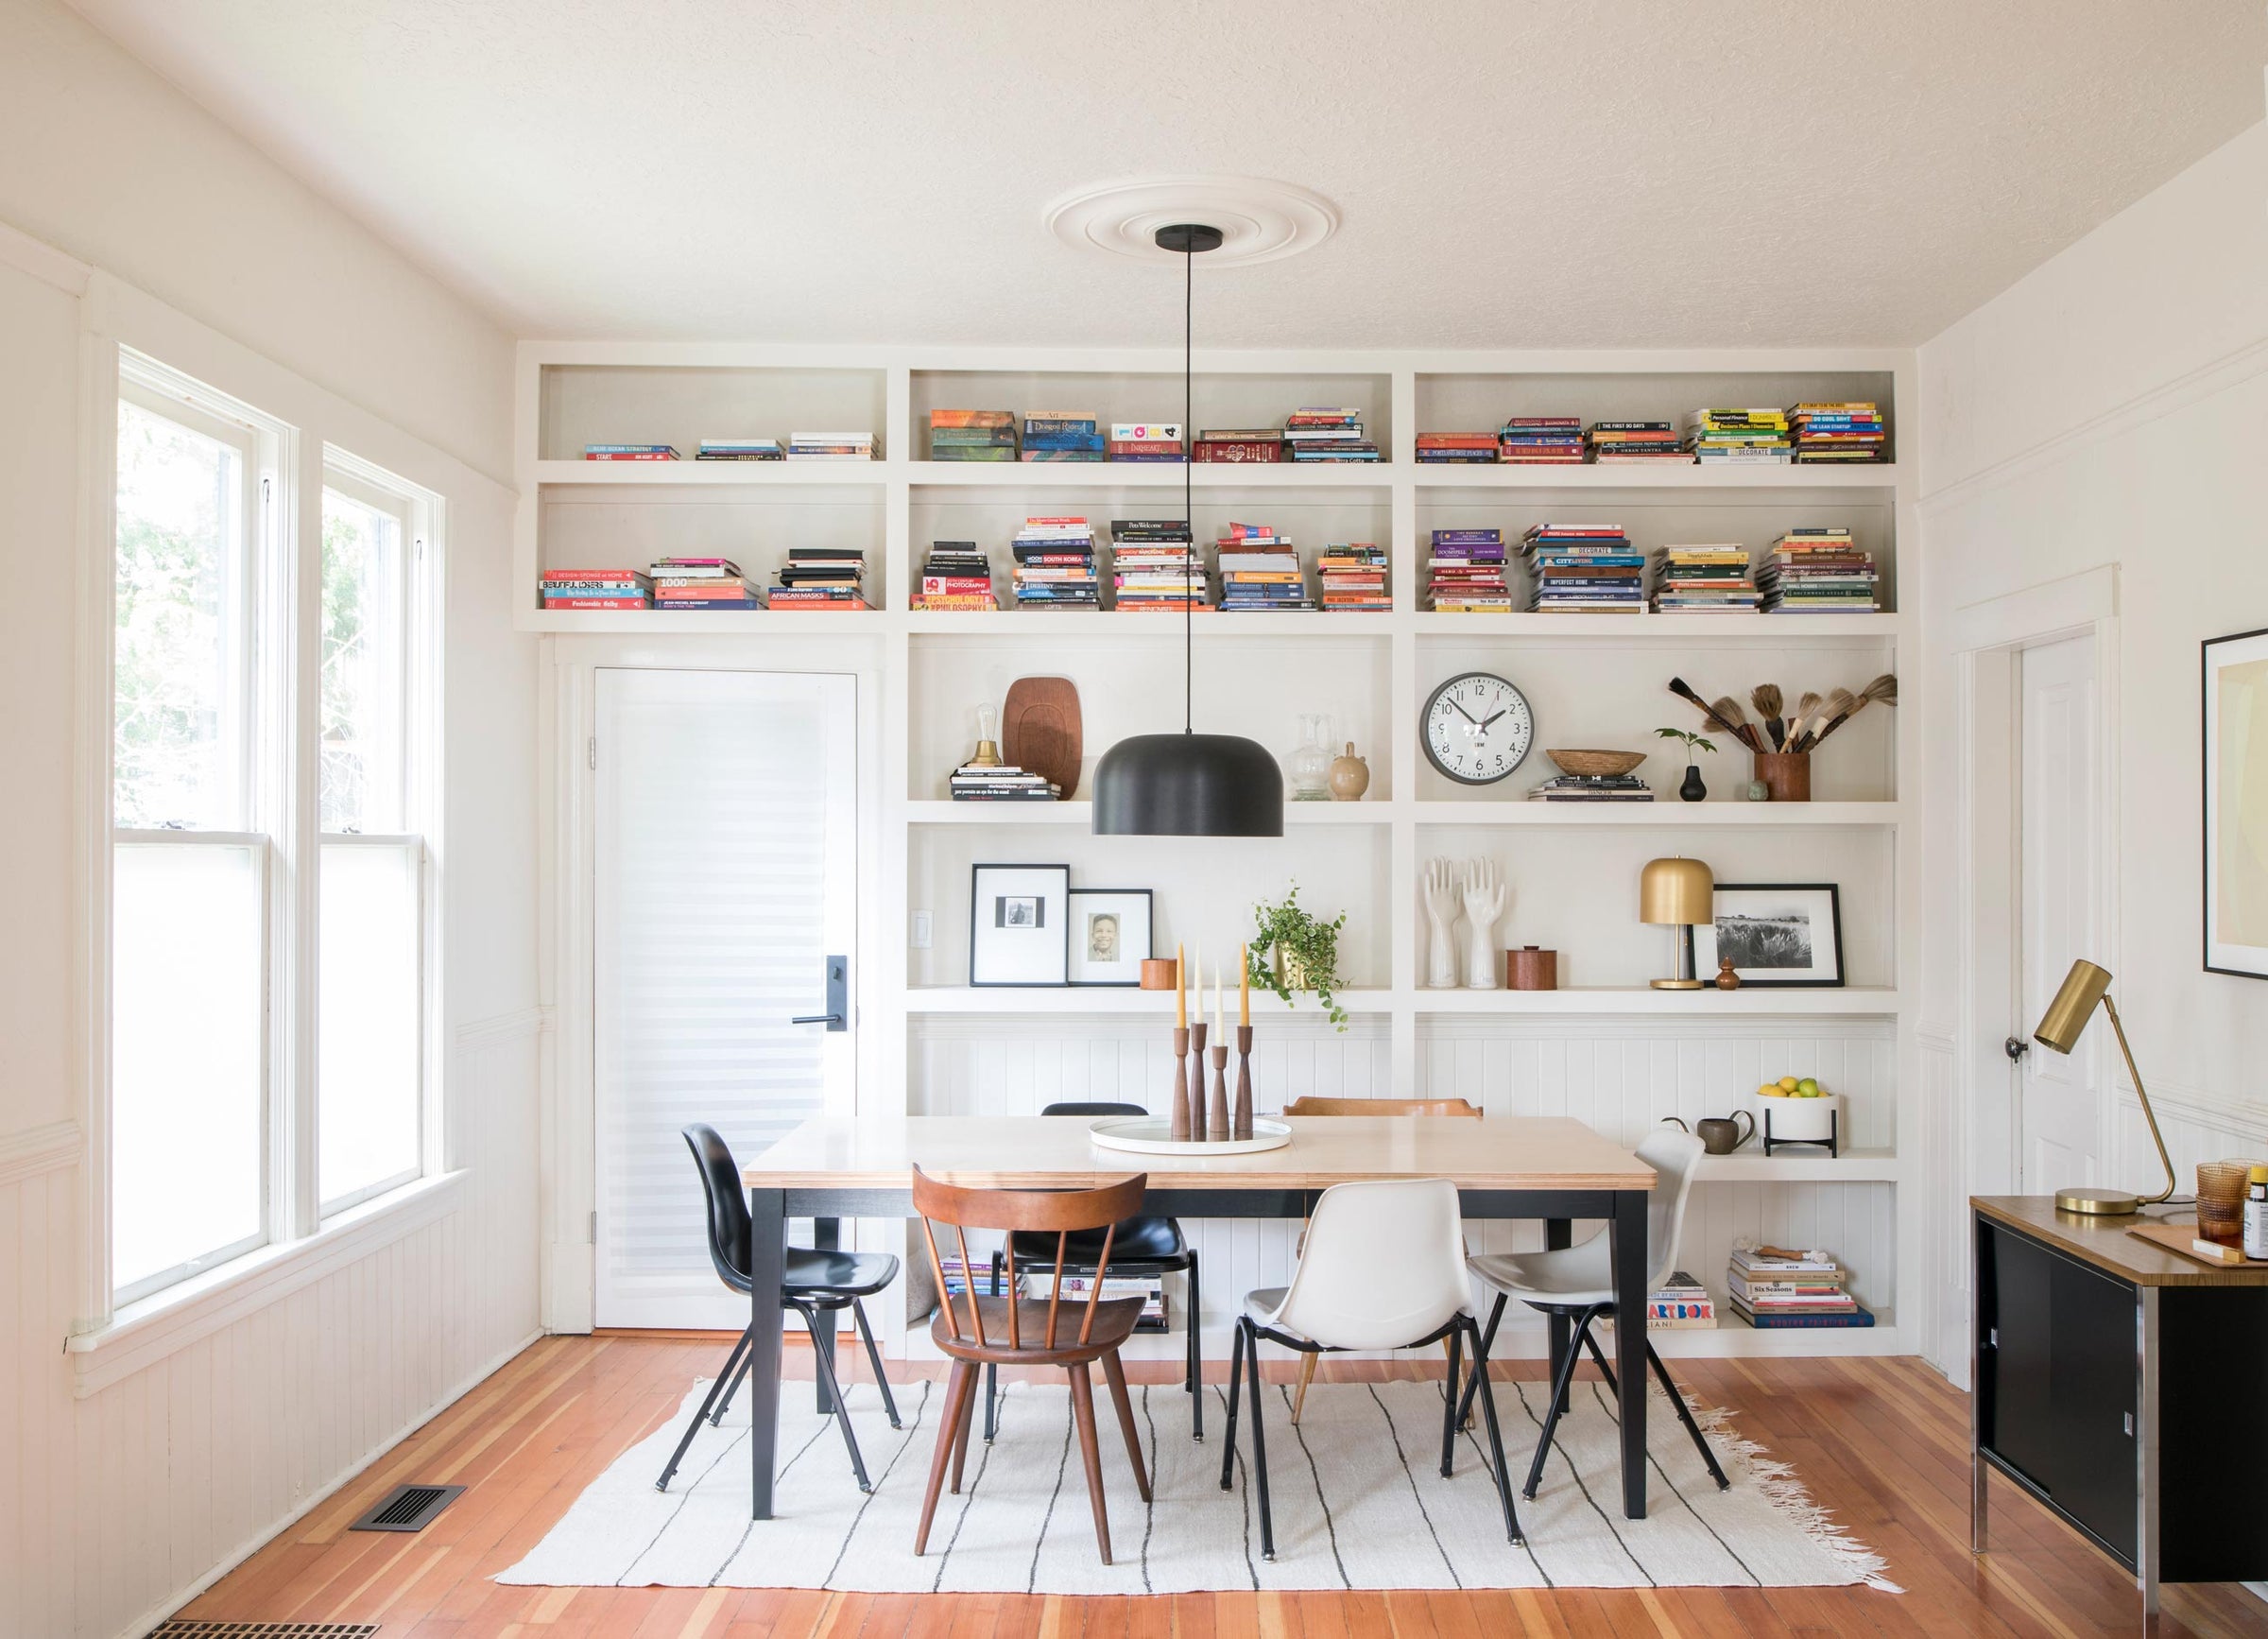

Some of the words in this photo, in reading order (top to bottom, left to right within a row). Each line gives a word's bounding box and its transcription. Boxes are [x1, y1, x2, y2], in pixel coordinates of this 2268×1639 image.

[1035, 422, 1061, 431] Dragon
[1062, 422, 1081, 431] Rider
[661, 578, 687, 587] 1000
[1475, 685, 1485, 695] 12
[1457, 690, 1464, 701] 11
[1442, 704, 1452, 714] 10
[1509, 704, 1515, 714] 2
[1439, 723, 1444, 734] 9
[1514, 723, 1520, 734] 3
[1442, 742, 1450, 753] 8
[1509, 742, 1516, 752] 4
[1457, 755, 1463, 765] 7
[1476, 759, 1483, 770] 6
[1496, 755, 1502, 766] 5
[1649, 1304, 1675, 1319] ART
[1678, 1304, 1711, 1319] BOOK
